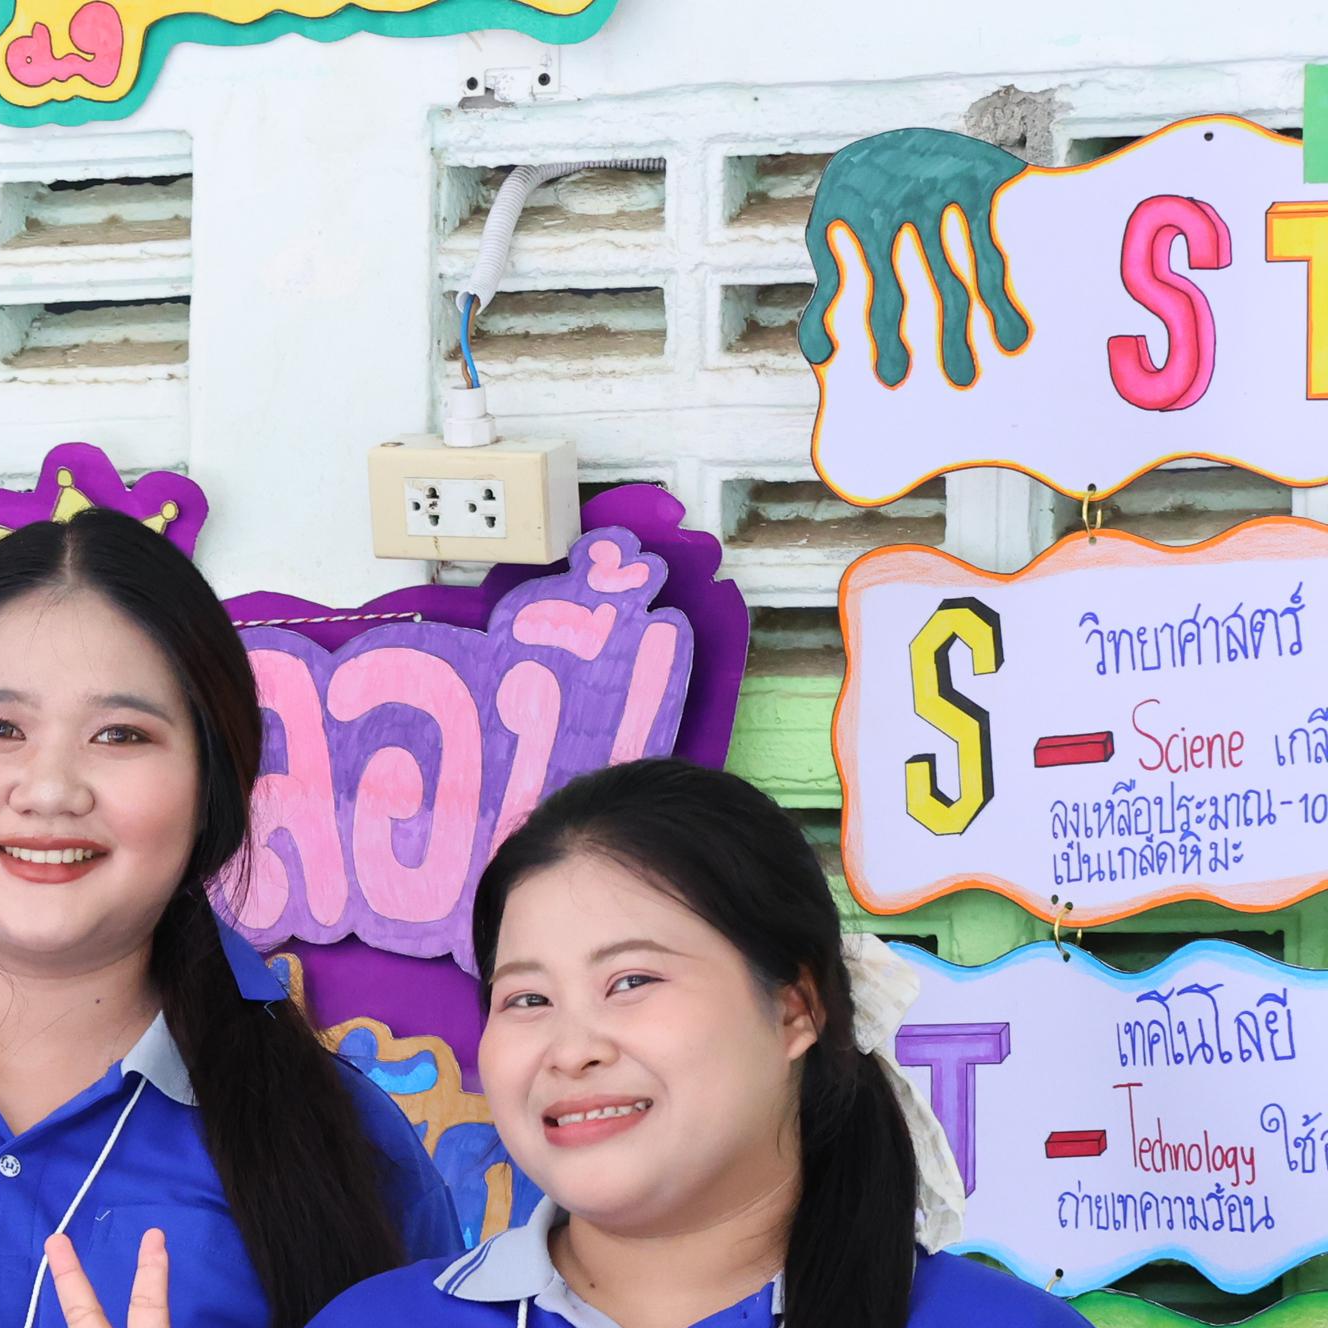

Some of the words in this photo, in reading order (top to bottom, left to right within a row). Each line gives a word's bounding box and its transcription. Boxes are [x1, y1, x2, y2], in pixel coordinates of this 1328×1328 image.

[1079, 582, 1304, 675] วิทยาศาสตร์
[905, 597, 1004, 836] S
[1132, 699, 1245, 775] Sciene
[895, 1022, 1011, 1199] T
[1113, 1082, 1255, 1187] Technology
[1260, 1103, 1328, 1173] ใช้
[1058, 1181, 1275, 1232] ถ่ายเทความร้อน
